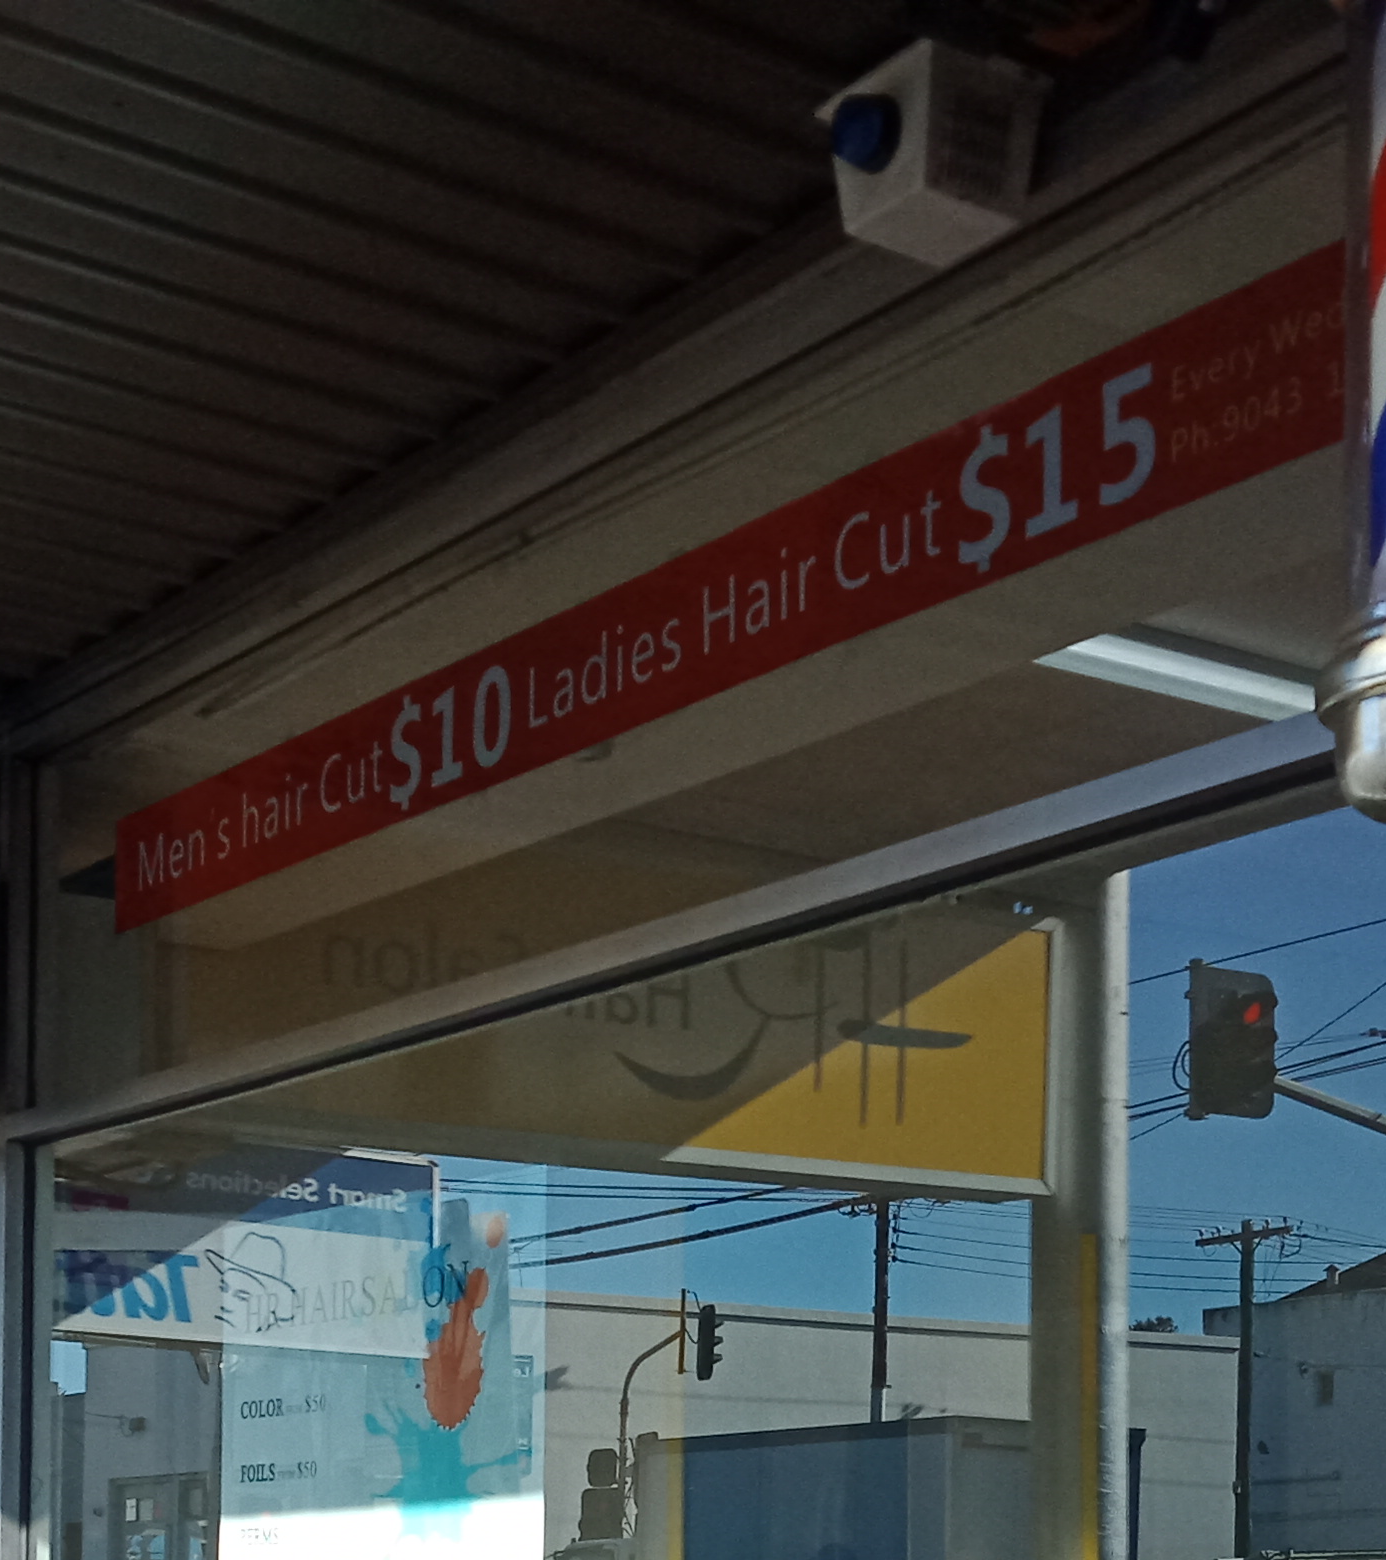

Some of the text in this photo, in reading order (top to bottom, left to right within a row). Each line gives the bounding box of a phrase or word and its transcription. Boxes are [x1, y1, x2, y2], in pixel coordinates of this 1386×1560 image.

[242, 773, 309, 848] hair
[321, 741, 383, 813] Cut
[387, 664, 512, 812] $10
[529, 617, 682, 728] Ladies
[702, 547, 817, 655] Hair
[834, 487, 942, 590] Cut
[956, 363, 1158, 572] $15
[240, 1398, 284, 1420] COLOR
[240, 1463, 276, 1483] FOILS
